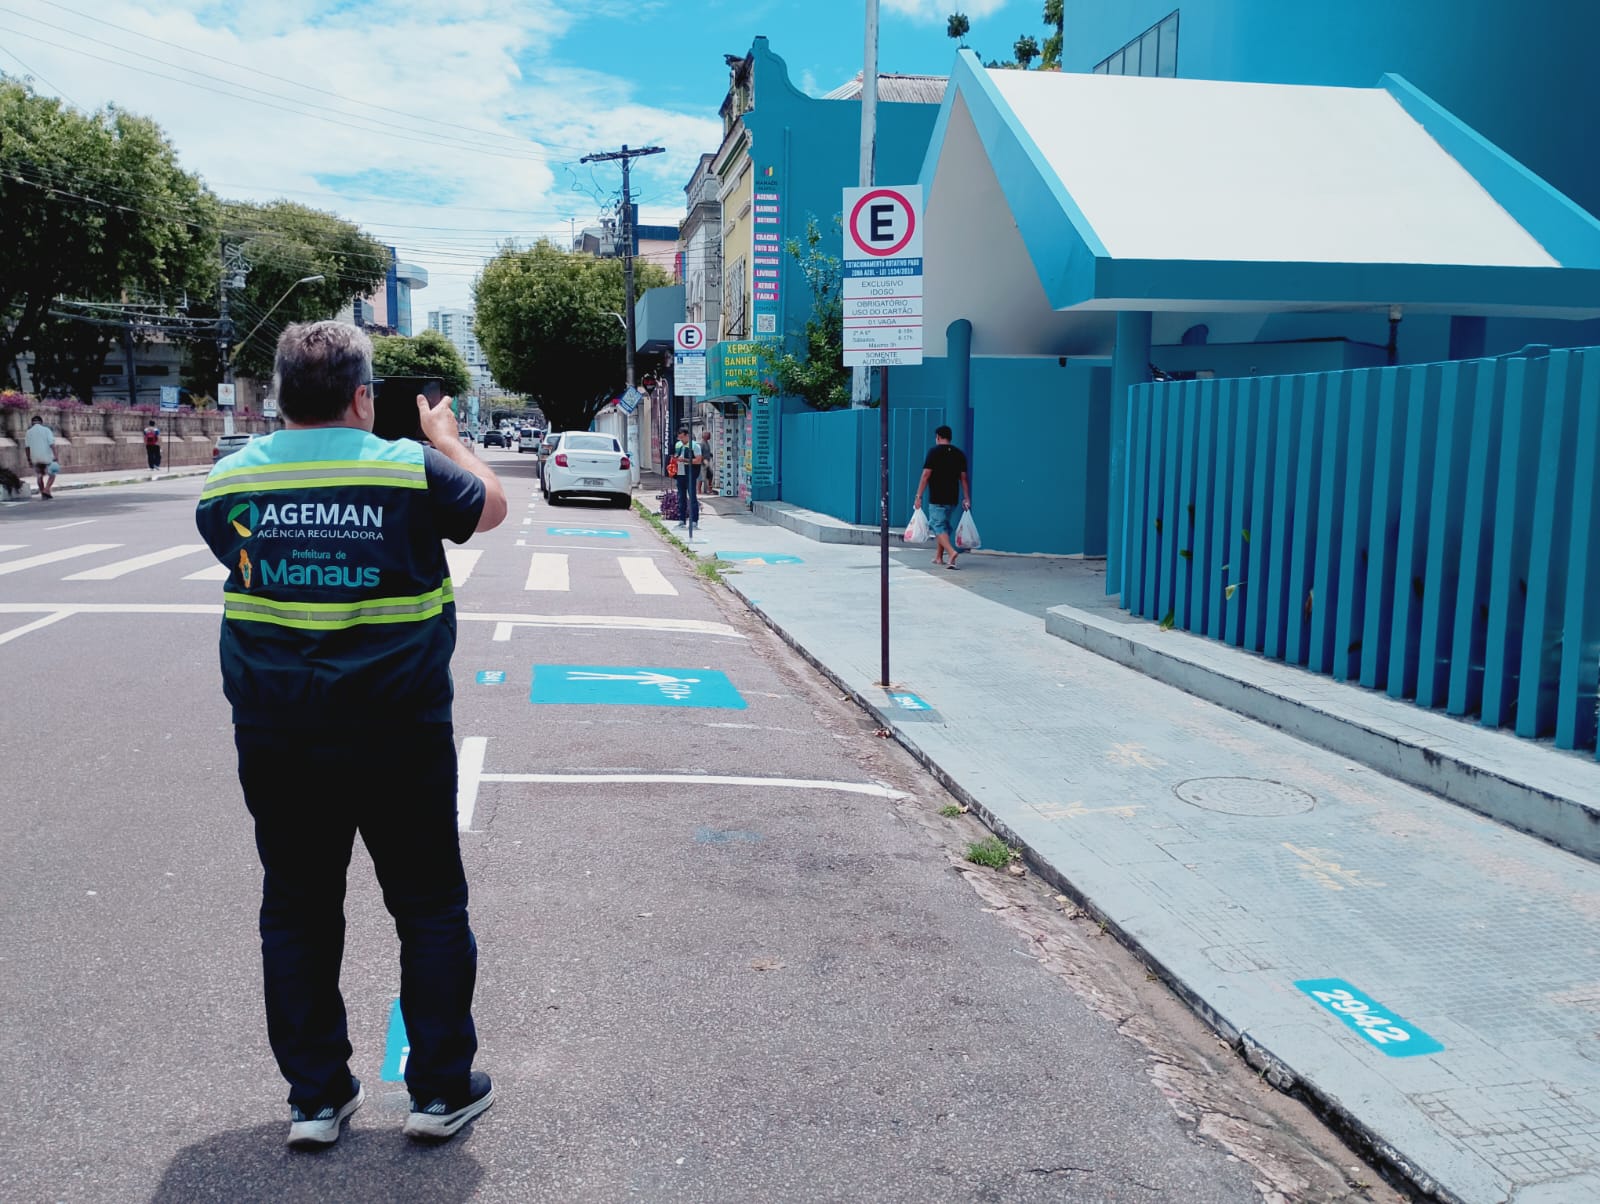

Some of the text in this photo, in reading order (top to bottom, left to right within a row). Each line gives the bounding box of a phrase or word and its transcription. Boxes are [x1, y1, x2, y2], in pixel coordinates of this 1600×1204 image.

[871, 204, 894, 241] E
[851, 269, 864, 277] ZONA
[861, 280, 904, 288] EXCLUSIVO
[870, 288, 894, 296] IDOSO
[856, 299, 908, 308] OBRIGATÓRIO
[882, 306, 913, 315] CARTÃO
[685, 329, 695, 345] E
[724, 356, 757, 366] BANNER
[260, 503, 383, 528] AGEMAN
[257, 528, 384, 541] AGÊNCIA REGULADORA
[292, 549, 347, 560] Prefeitura de
[260, 558, 381, 588] Manaus
